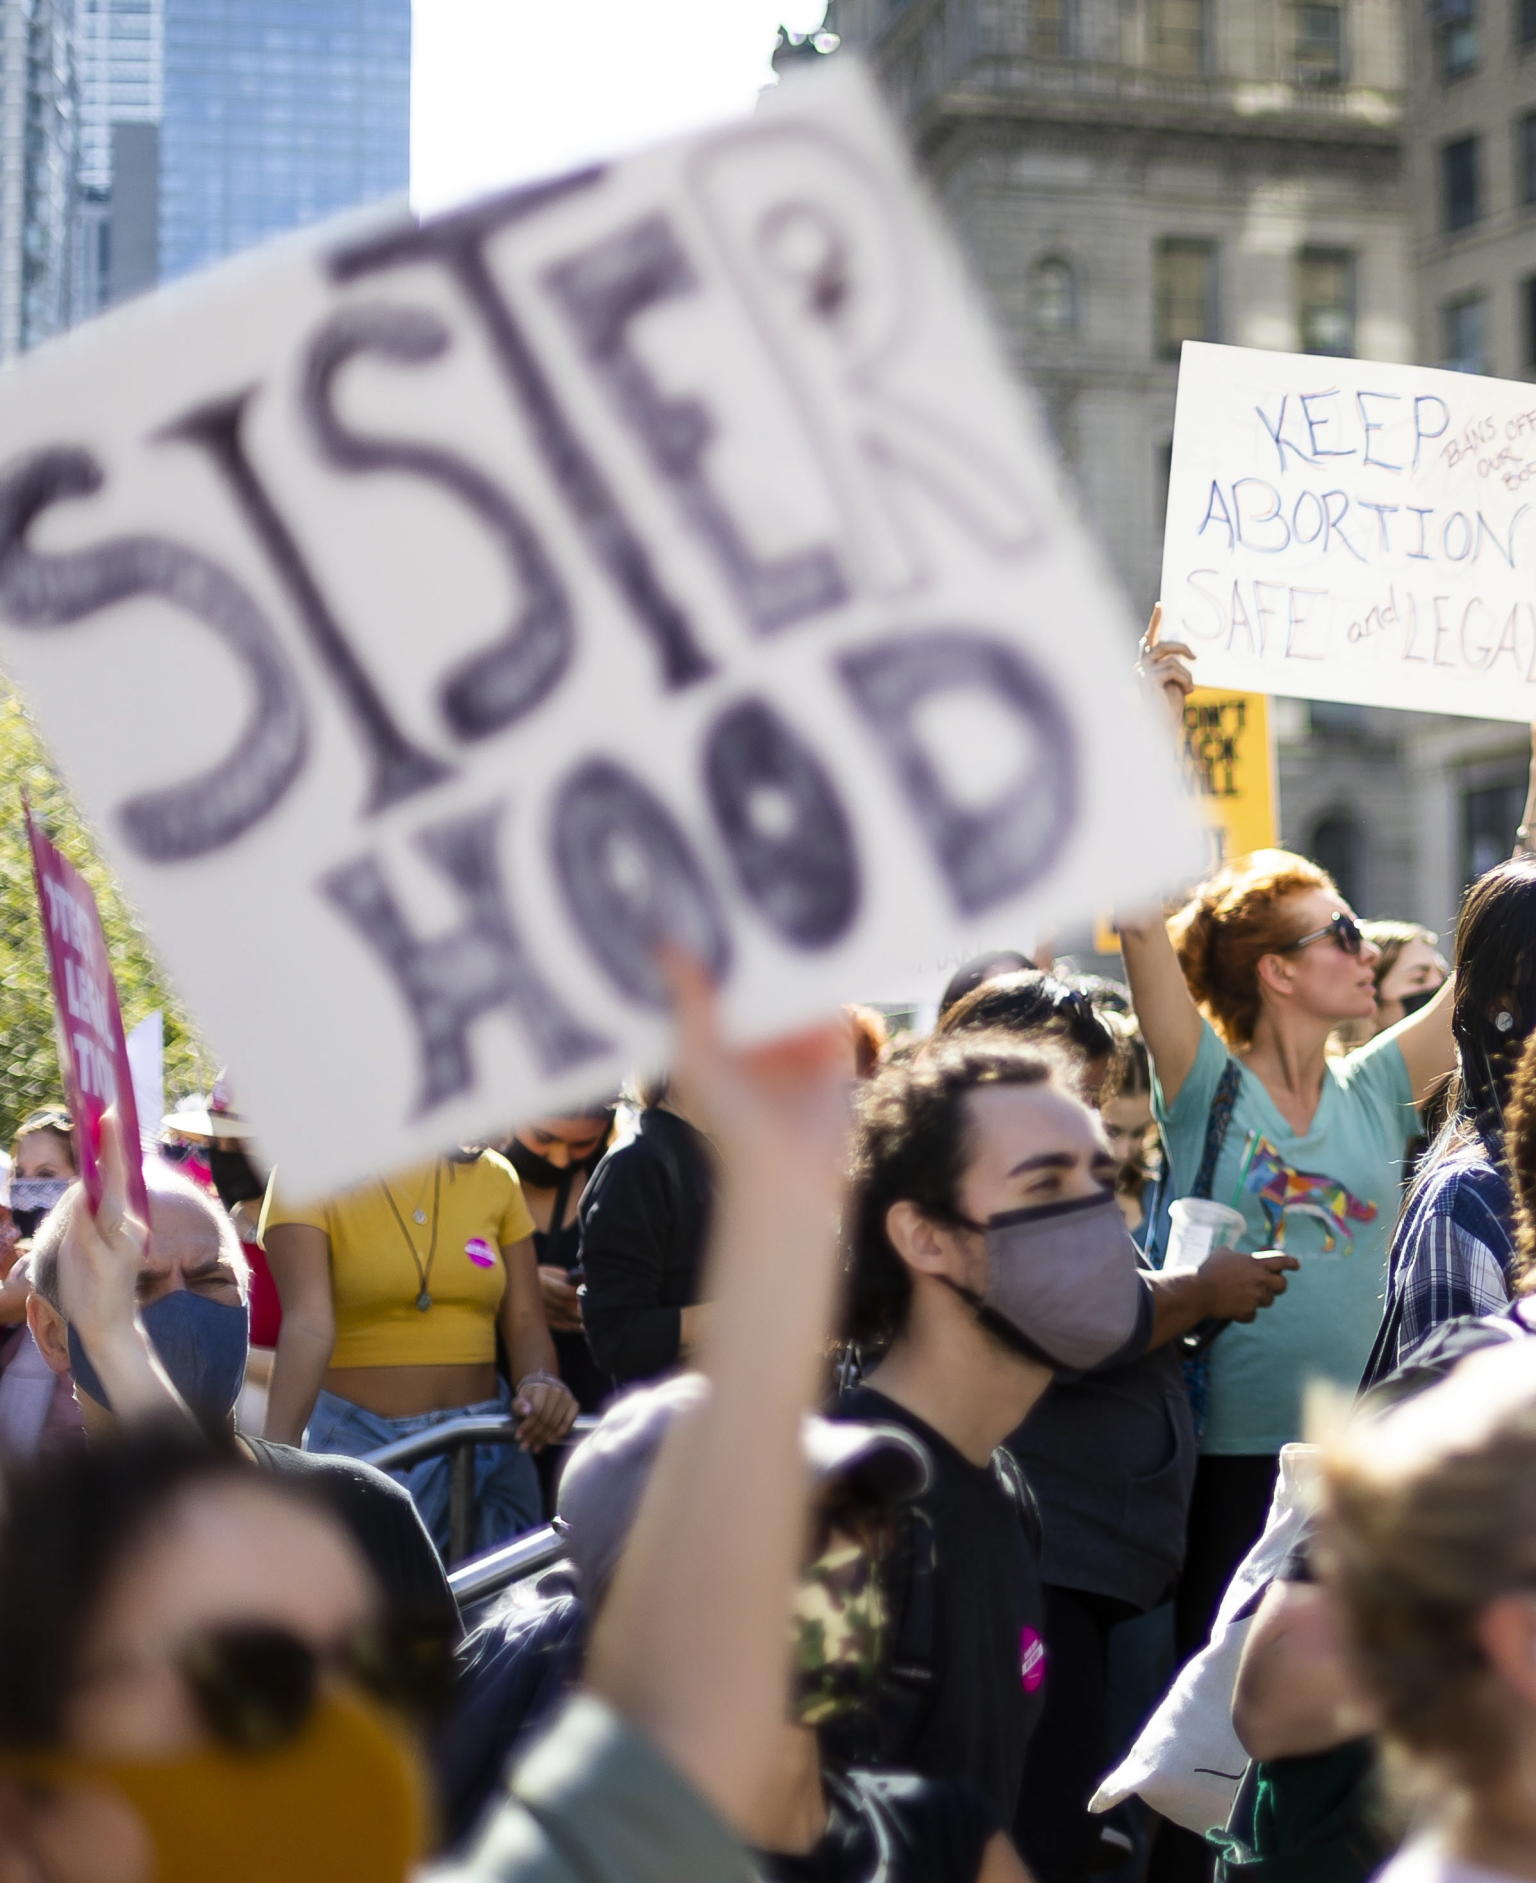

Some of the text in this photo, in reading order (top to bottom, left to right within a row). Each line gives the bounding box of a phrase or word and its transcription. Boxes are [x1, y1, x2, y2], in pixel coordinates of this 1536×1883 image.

[1255, 386, 1450, 477] KEEP
[1440, 414, 1497, 468] BANS
[1476, 446, 1524, 479] OUR
[0, 122, 1052, 866] SISTER
[1198, 477, 1532, 569] ABORTION
[1181, 568, 1329, 660] SAFE
[1347, 583, 1399, 644] and
[320, 630, 1085, 1124] HOOD
